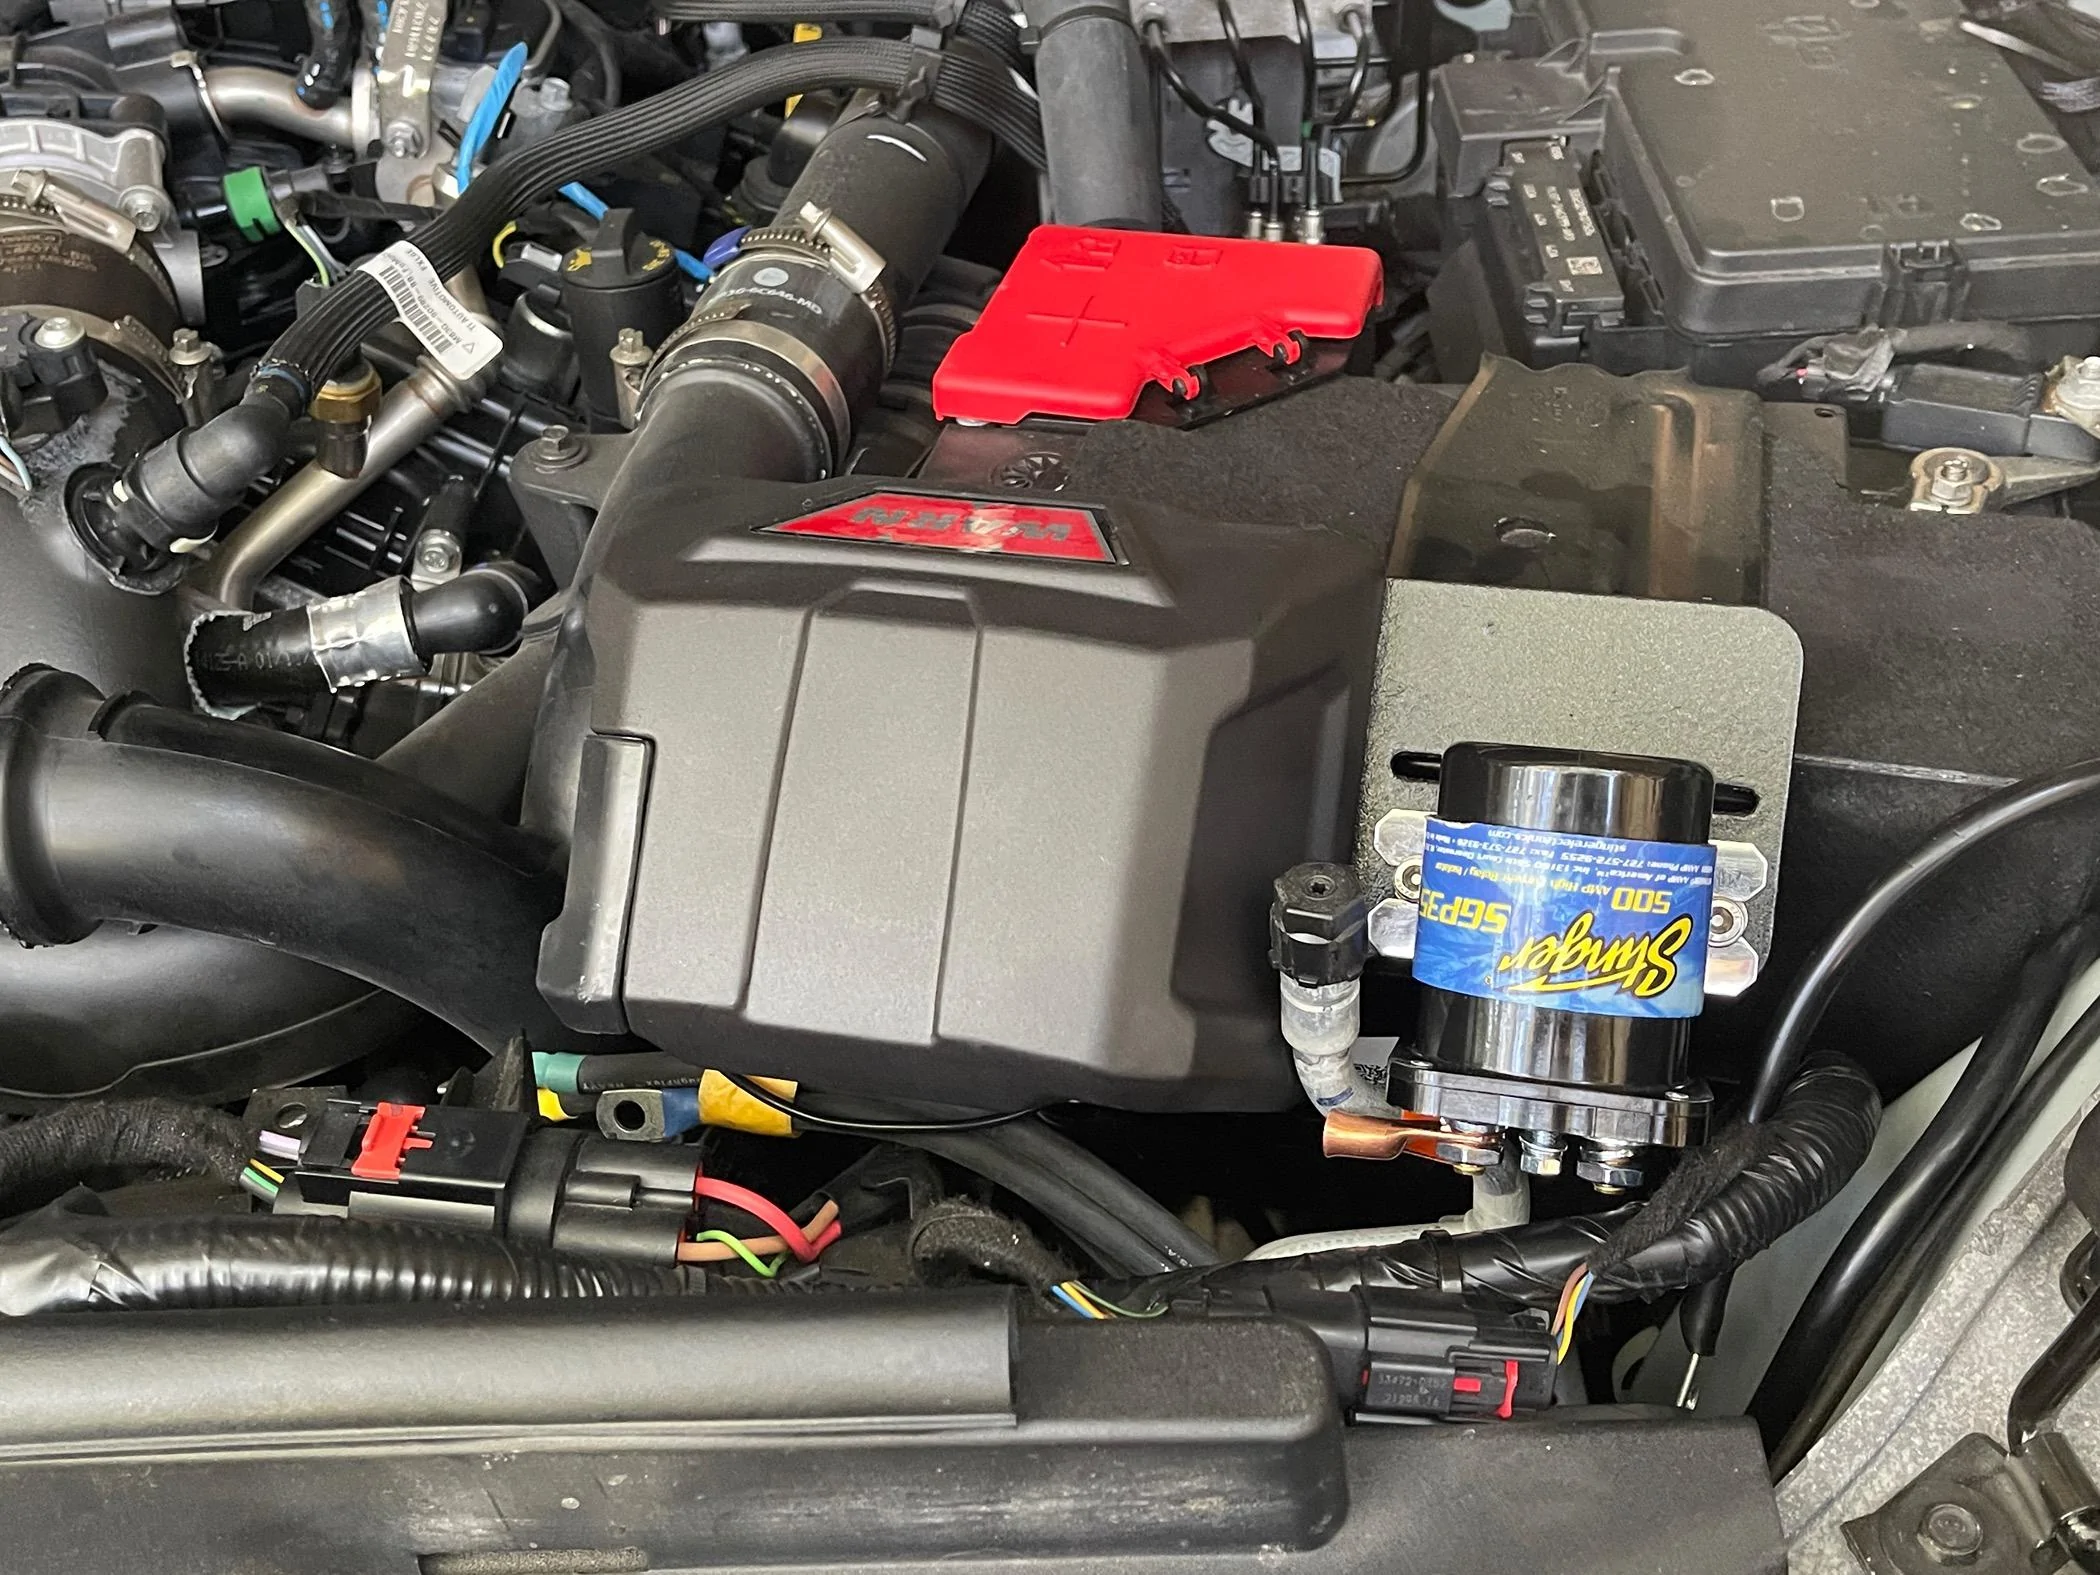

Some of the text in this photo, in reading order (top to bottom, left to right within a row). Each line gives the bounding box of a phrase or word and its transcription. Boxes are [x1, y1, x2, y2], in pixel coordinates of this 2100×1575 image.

[428, 277, 470, 324] AUTOMOTIVE
[850, 507, 1071, 541] WARN
[1487, 829, 1627, 853] stingerelectronics.com
[1560, 851, 1645, 869] 727-572-9255
[1647, 861, 1679, 872] Phone:
[1551, 879, 1579, 893] High
[1581, 883, 1612, 895] AMP
[1611, 887, 1673, 914] 500
[1497, 908, 1693, 999] Stinger
